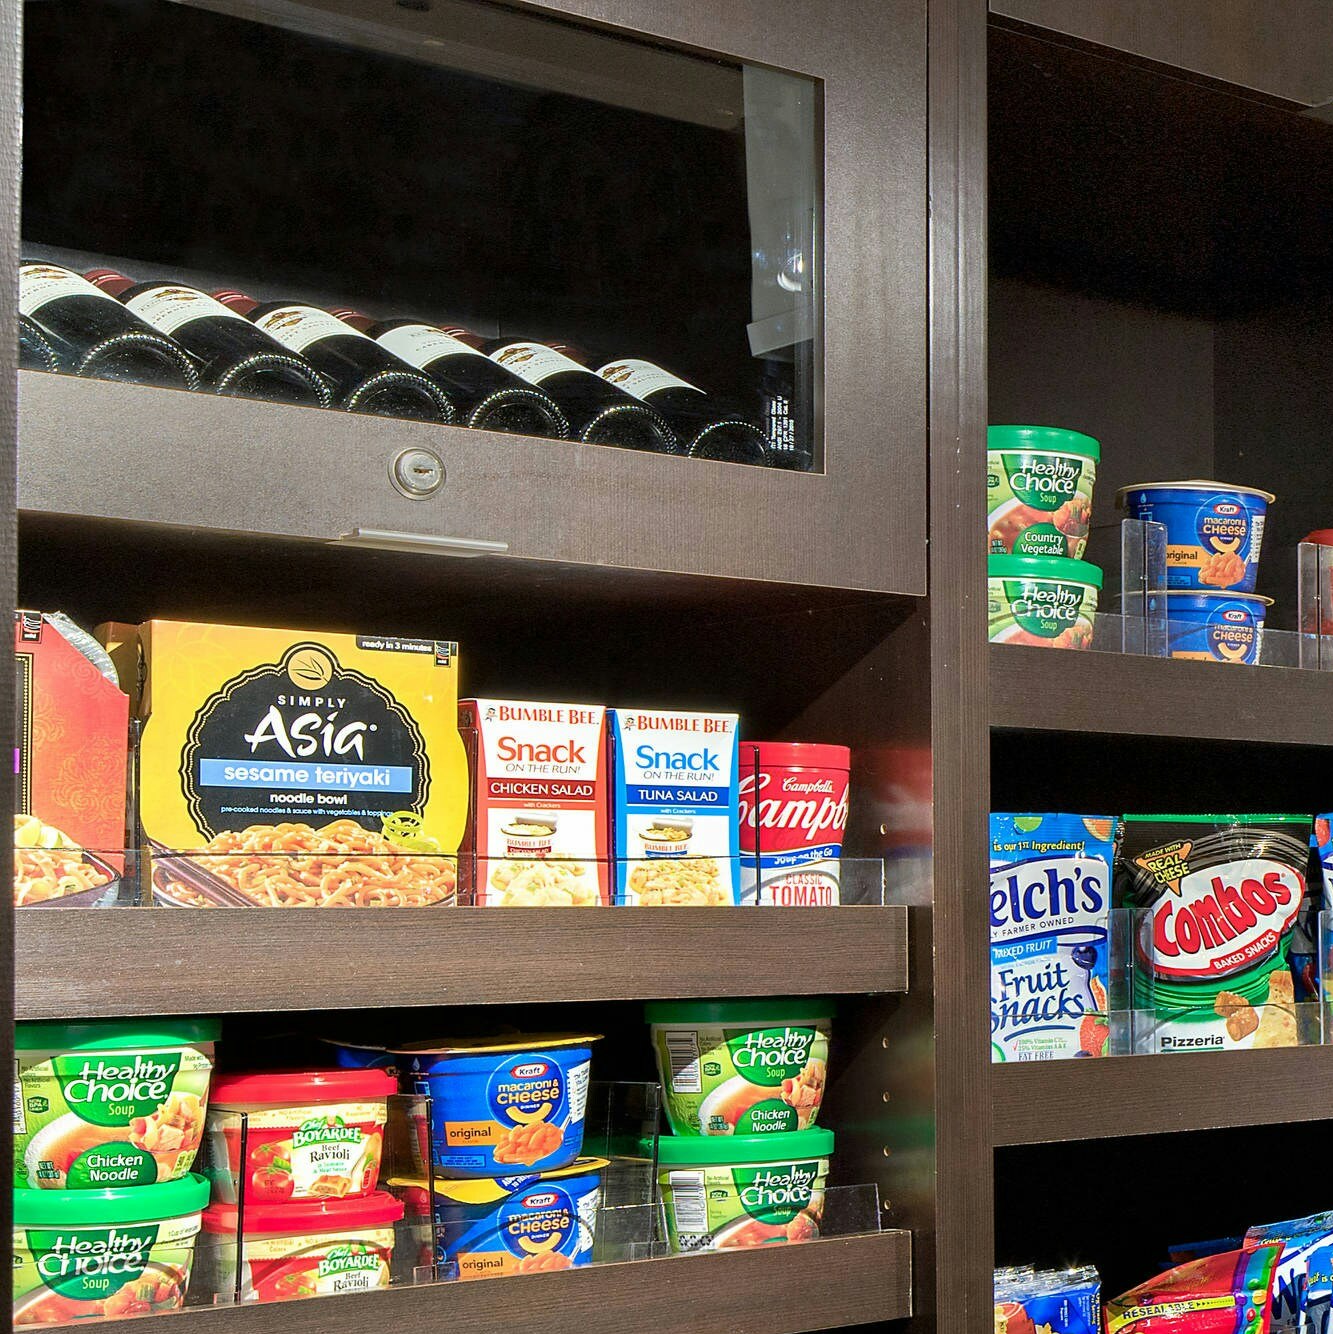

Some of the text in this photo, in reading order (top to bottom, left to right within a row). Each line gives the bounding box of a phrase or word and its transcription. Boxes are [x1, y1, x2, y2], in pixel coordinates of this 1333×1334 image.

[1021, 457, 1080, 481] Healthy
[1010, 472, 1075, 494] Choice
[1040, 492, 1057, 504] Soup
[1219, 505, 1235, 513] Kraft
[1025, 531, 1063, 545] Country
[1021, 543, 1064, 556] Vegetable
[1022, 585, 1081, 608] Healthy
[277, 694, 347, 710] SIMPLY
[499, 706, 596, 725] BUMBLE BEE
[637, 715, 729, 733] BUMBLE BEE
[244, 705, 368, 761] Asia
[497, 736, 586, 764] Snack
[635, 745, 720, 771] Snack
[224, 766, 390, 788] sesame teriyaki
[552, 765, 581, 774] RUN!
[665, 771, 714, 781] THE RUN!
[490, 782, 593, 796] CHICKEN SALAD
[638, 789, 718, 802] TUNA SALAD
[270, 793, 347, 805] noodle bowl
[1032, 840, 1085, 852] Ingredient!
[1144, 848, 1164, 859] MADE
[1148, 855, 1182, 873] REAL
[786, 872, 823, 885] CLASSIC
[1154, 864, 1190, 885] CHEESE
[769, 886, 832, 907] TOMATO
[1153, 872, 1292, 955] Combos
[1002, 917, 1074, 938] FARMER OWNED
[1213, 932, 1277, 969] BAKED SNACKS
[998, 962, 1071, 1001] Fruit
[745, 1027, 813, 1050] Healthy
[1160, 1034, 1224, 1048] Pizzeria
[732, 1045, 806, 1068] Choice
[79, 1055, 176, 1083] Healthy
[519, 1067, 541, 1076] Kraft
[766, 1067, 786, 1078] Soup
[64, 1078, 167, 1103] Choice
[498, 1080, 552, 1093] macaroni
[108, 1103, 135, 1118] Soup
[751, 1109, 790, 1120] Chicken
[450, 1127, 492, 1140] original
[752, 1120, 787, 1132] Noodle
[293, 1127, 362, 1149] BOYARDEE
[322, 1143, 340, 1152] Beef
[87, 1154, 143, 1168] Chicken
[310, 1149, 350, 1164] Ravioli
[90, 1168, 139, 1181] Noodle
[752, 1165, 817, 1188] Healthy
[530, 1196, 551, 1206] Kraft
[740, 1184, 812, 1206] Choice
[52, 1229, 153, 1255] Healthy
[318, 1254, 381, 1278] BOYARDEE
[462, 1257, 504, 1271] original
[345, 1272, 361, 1280] Beef
[82, 1277, 110, 1291] Soup
[333, 1277, 370, 1292] Ravioli
